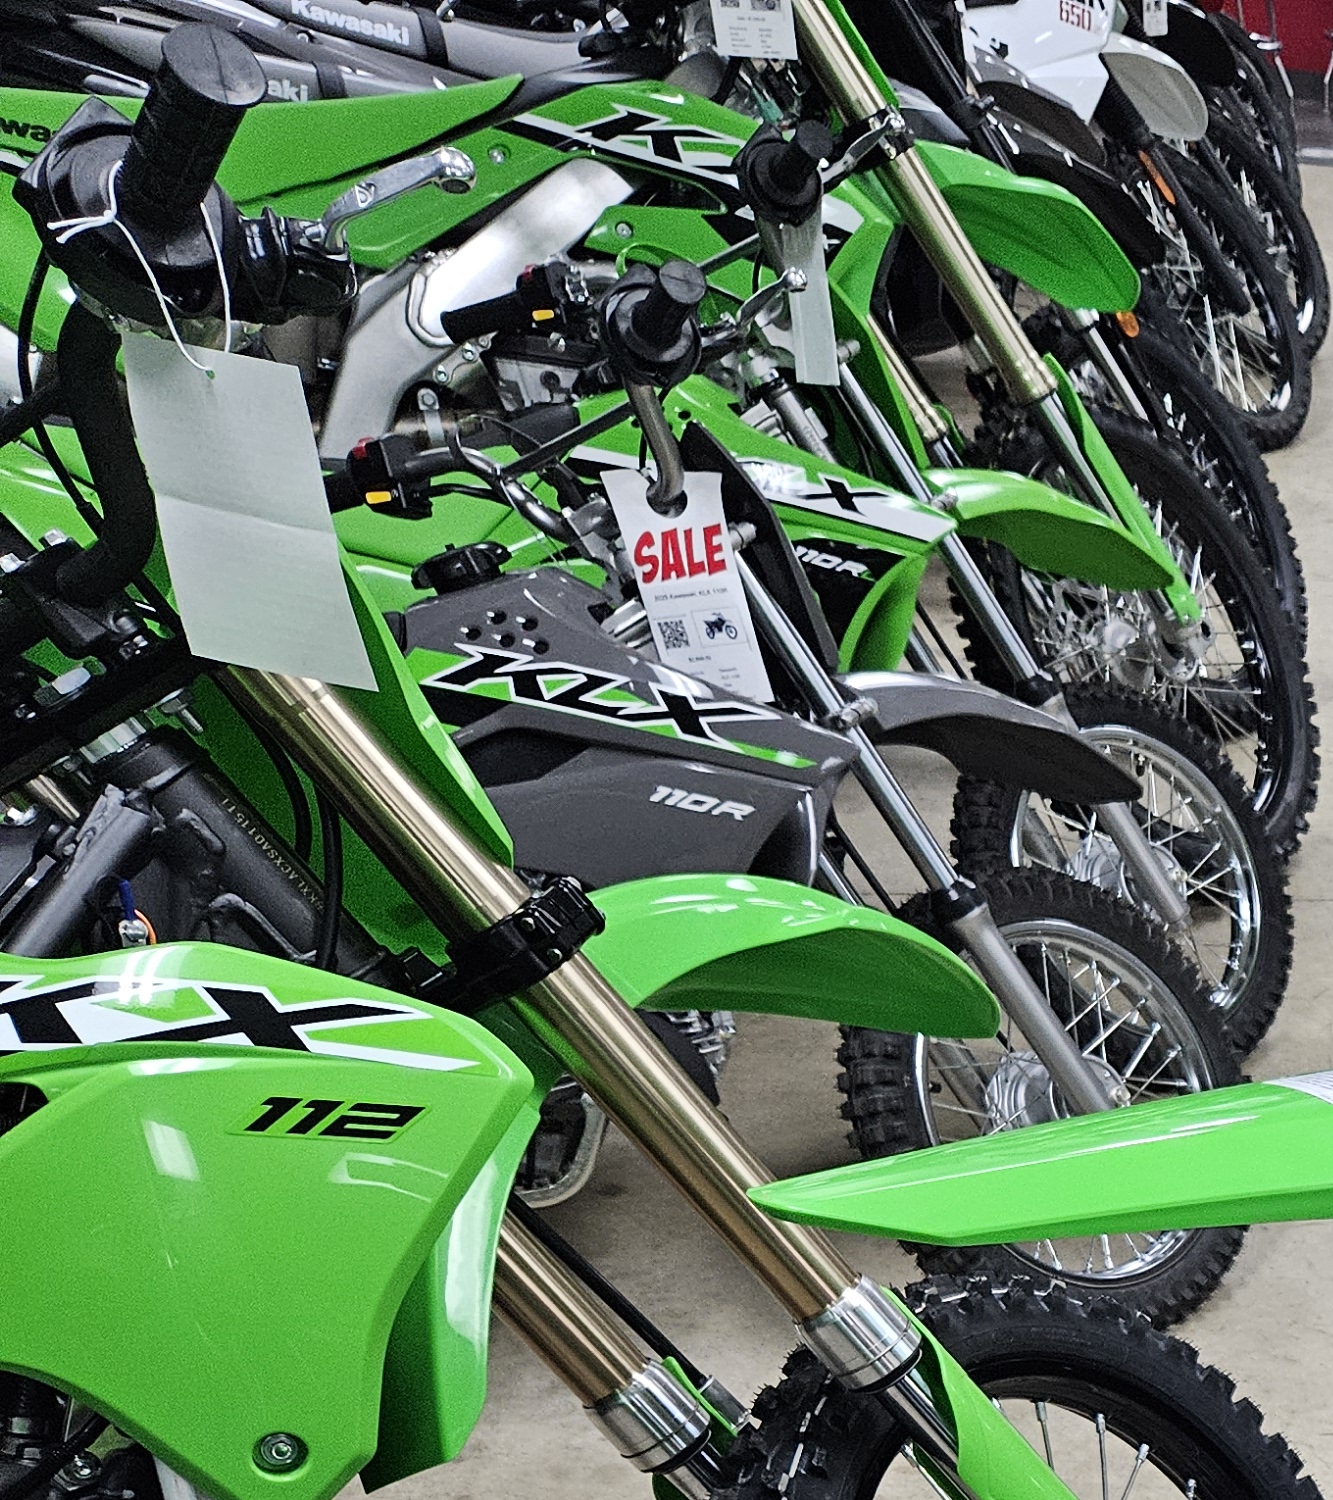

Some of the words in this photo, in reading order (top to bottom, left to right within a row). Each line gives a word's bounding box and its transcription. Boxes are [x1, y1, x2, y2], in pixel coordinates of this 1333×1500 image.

[291, 0, 409, 46] Kawasaki
[1059, 1, 1092, 32] 650
[633, 522, 728, 585] SALE
[422, 643, 780, 753] KLX
[650, 785, 756, 821] 110R
[243, 1096, 427, 1140] 112
